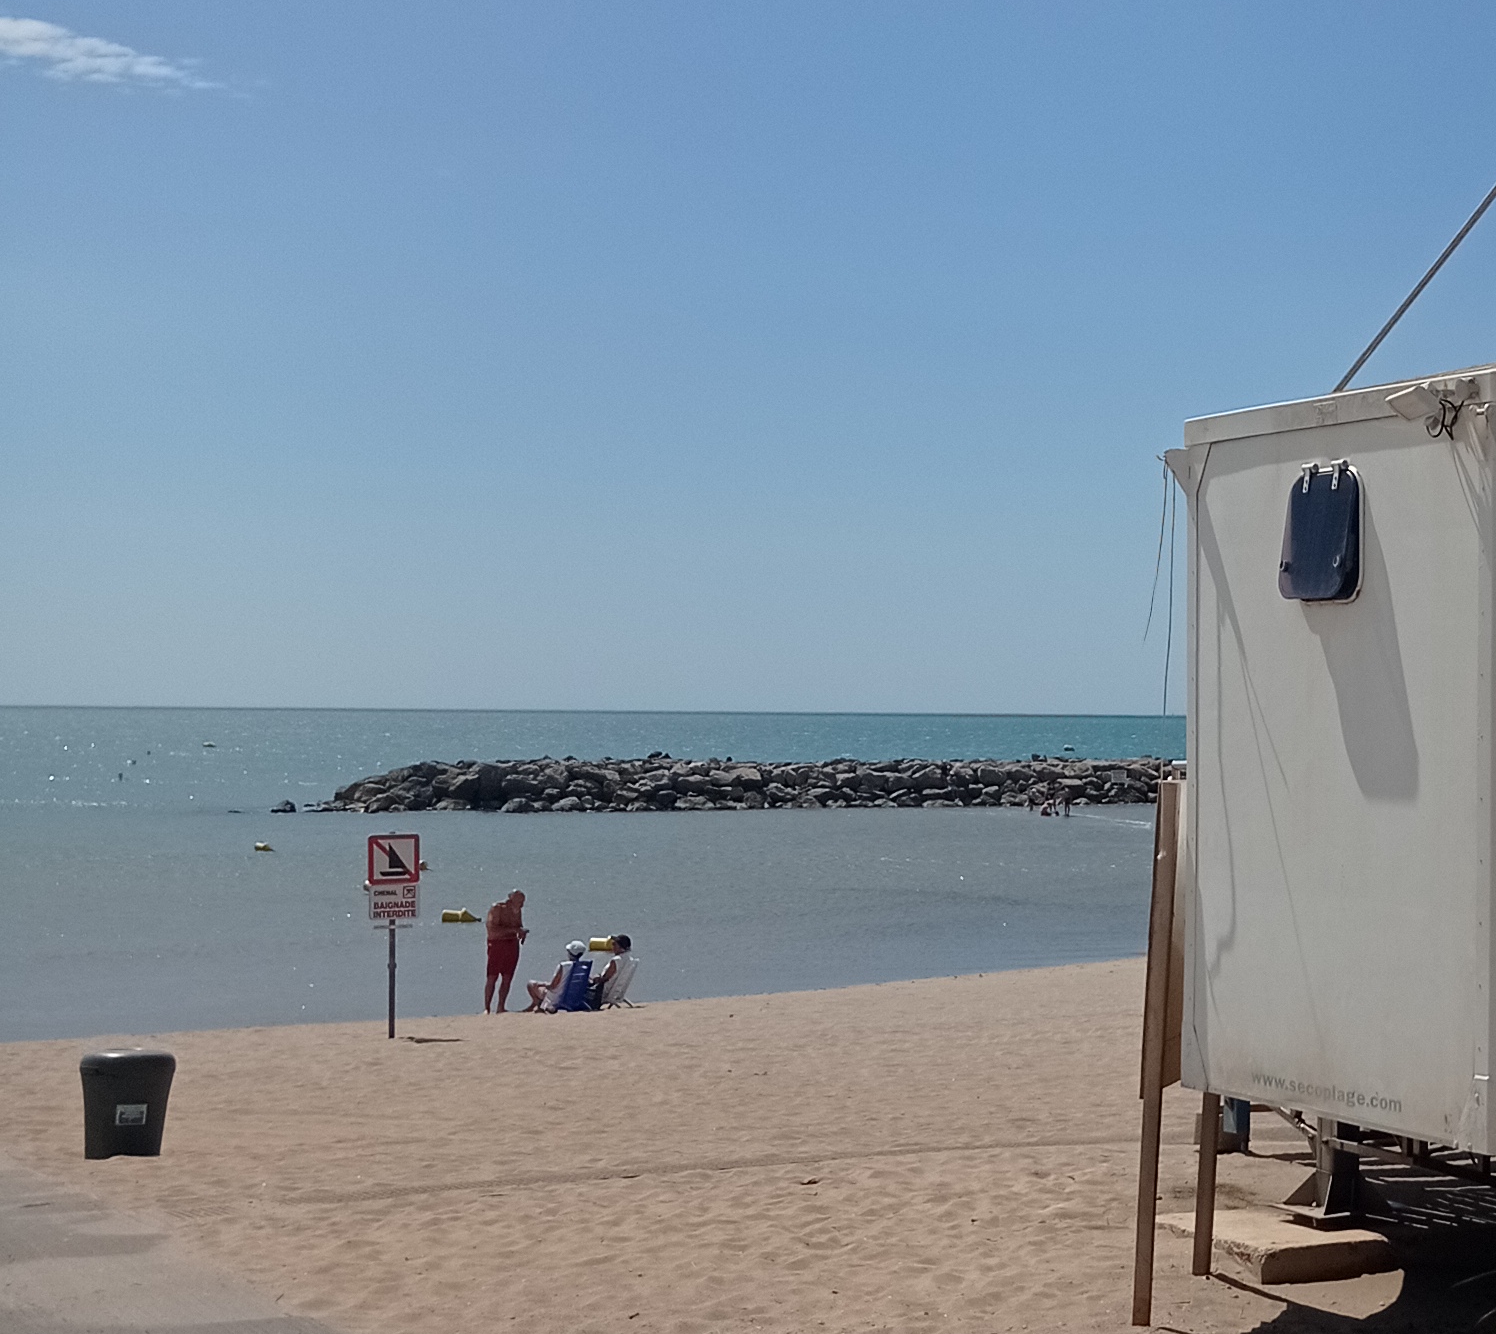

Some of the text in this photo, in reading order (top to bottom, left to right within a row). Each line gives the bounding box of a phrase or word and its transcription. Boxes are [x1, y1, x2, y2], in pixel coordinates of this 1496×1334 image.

[373, 900, 416, 910] BAIGNADE
[373, 909, 416, 918] INTERDITE
[1251, 1071, 1402, 1113] www.secoplage.com
